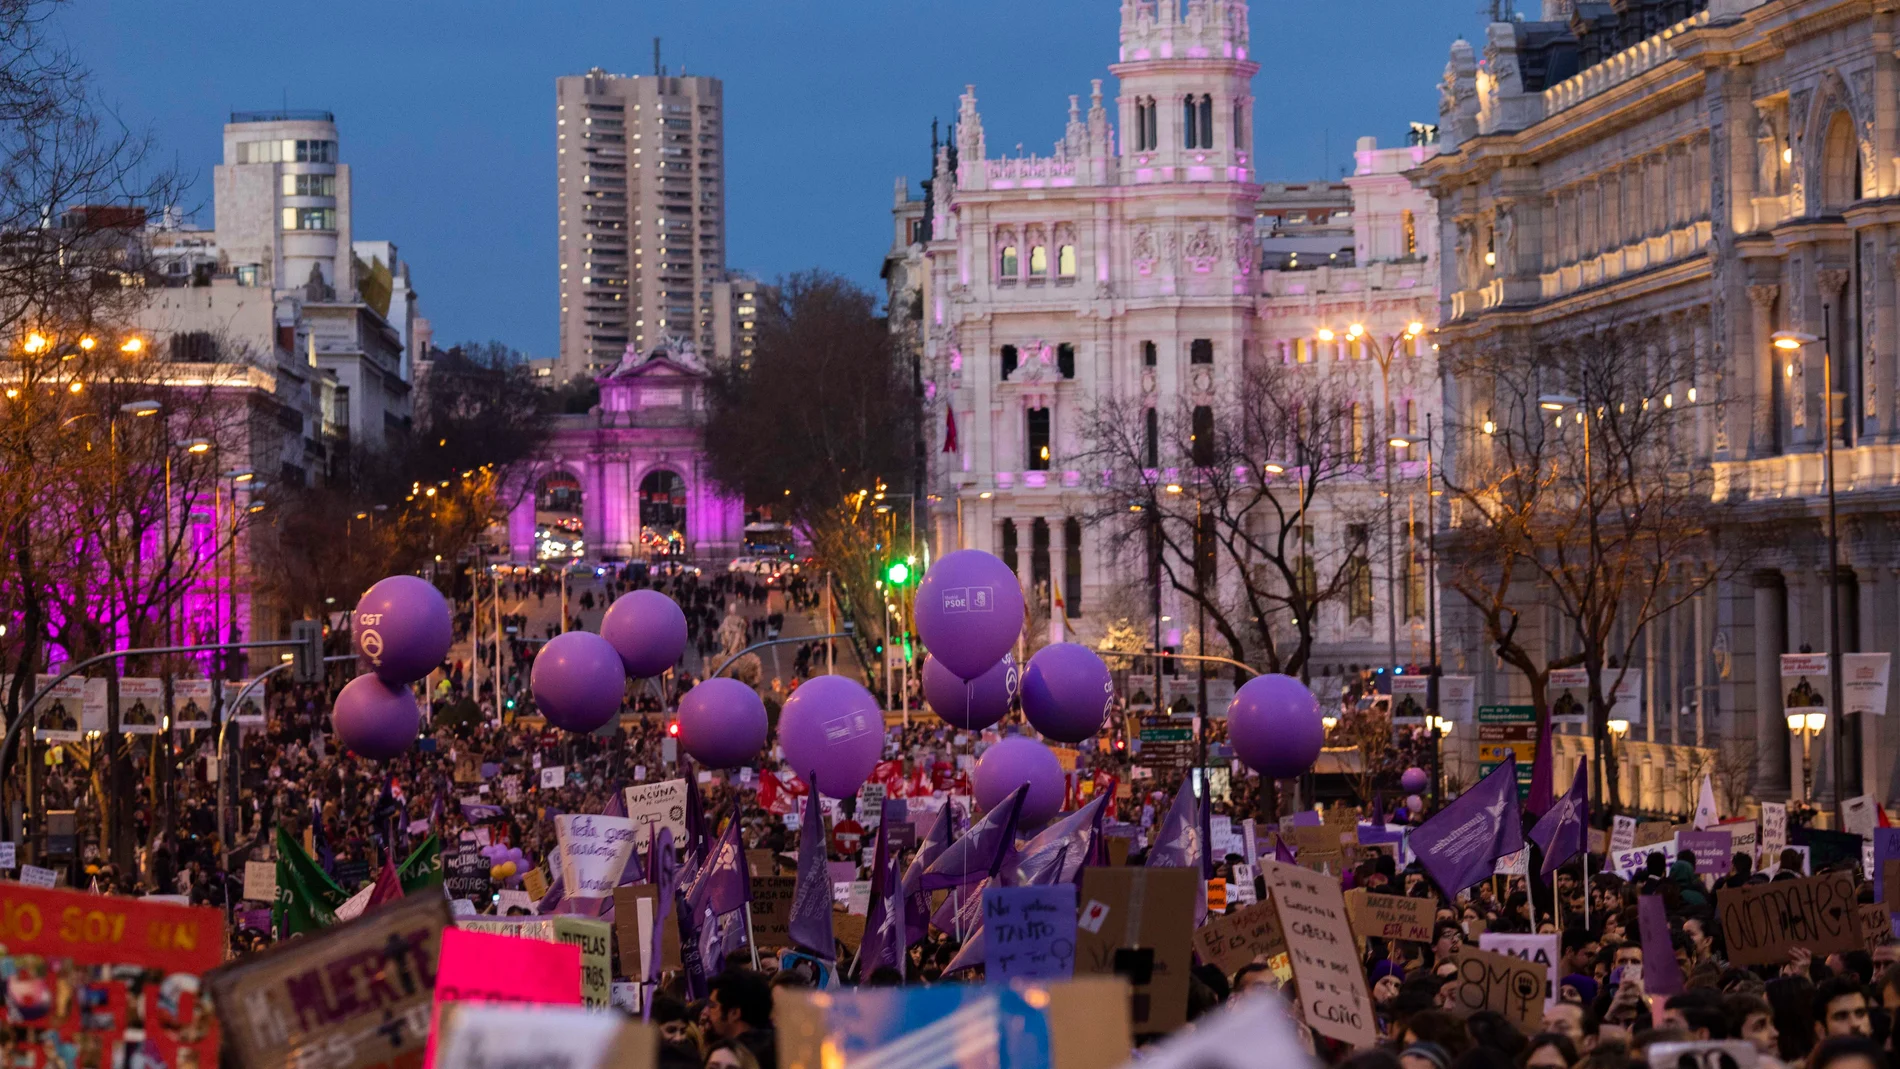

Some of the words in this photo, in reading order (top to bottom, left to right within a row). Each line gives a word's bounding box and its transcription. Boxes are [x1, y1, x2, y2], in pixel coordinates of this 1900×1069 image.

[945, 599, 966, 608] PSOE
[360, 613, 383, 626] CGT
[631, 786, 677, 802] VACUNA
[60, 905, 126, 943] SOY
[994, 920, 1055, 943] TANTO
[1408, 925, 1431, 939] MAL
